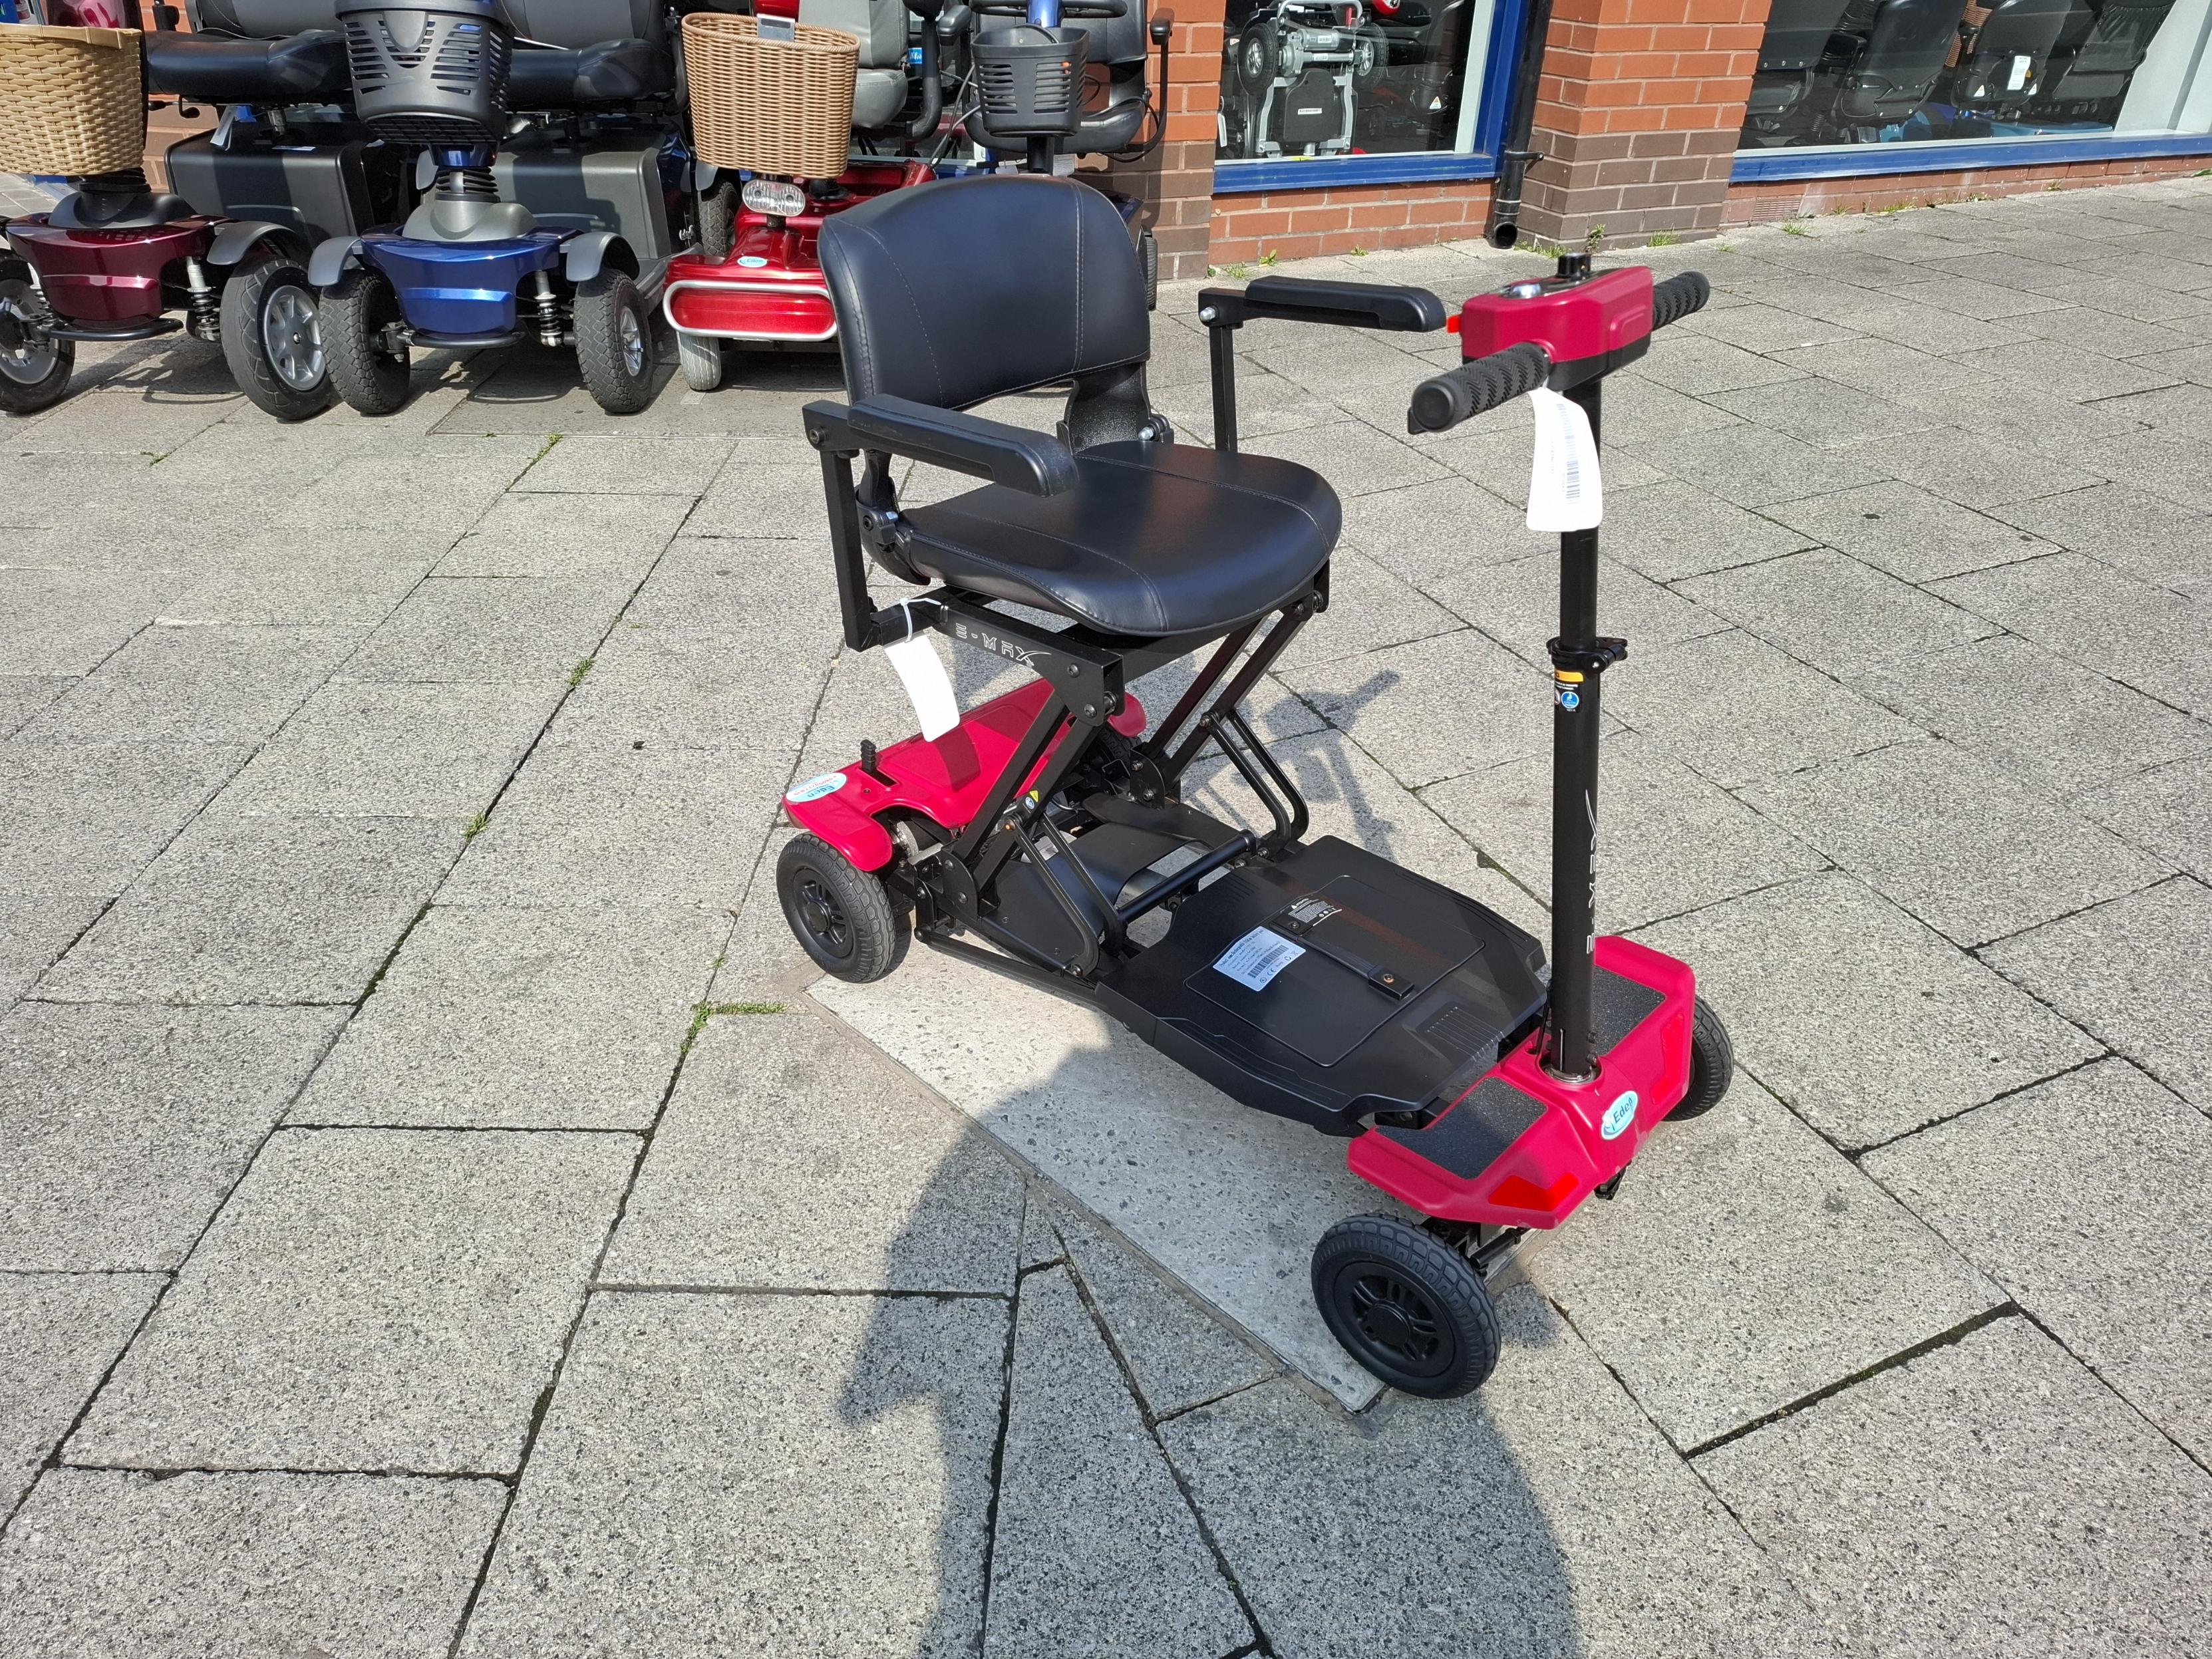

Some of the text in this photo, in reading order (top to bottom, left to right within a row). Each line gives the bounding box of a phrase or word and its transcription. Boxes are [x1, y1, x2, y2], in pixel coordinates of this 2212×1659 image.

[955, 623, 1052, 666] E-MAX
[808, 785, 835, 798] Eden
[1613, 1097, 1633, 1124] Eden
